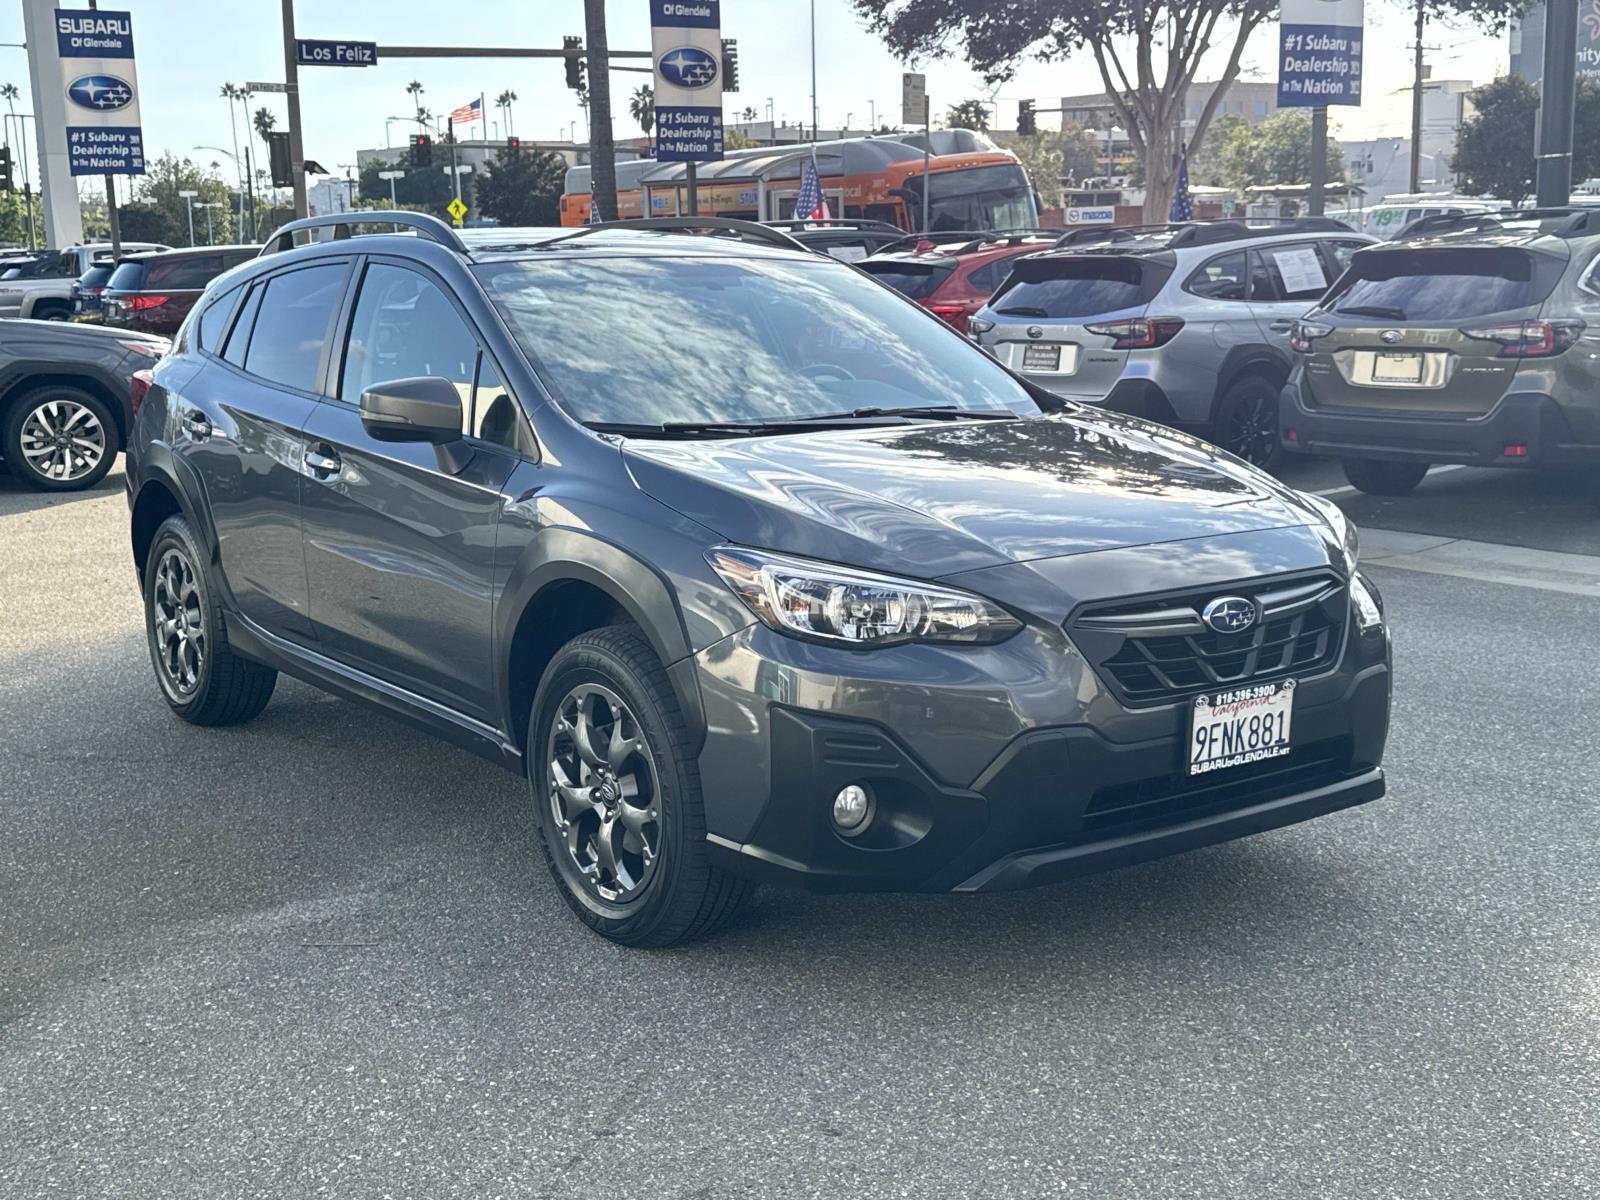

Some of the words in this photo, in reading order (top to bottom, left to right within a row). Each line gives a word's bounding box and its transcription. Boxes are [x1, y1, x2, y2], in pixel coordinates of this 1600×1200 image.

[663, 4, 674, 15] Of
[675, 4, 711, 17] Glendale
[58, 18, 130, 35] SUBARU
[71, 37, 82, 47] Of
[83, 37, 122, 48] Glendale
[1284, 34, 1303, 51] #1
[1305, 34, 1347, 51] Subaru
[302, 44, 331, 60] Los
[336, 45, 372, 62] Feliz
[1284, 56, 1349, 77] Dealership
[1303, 78, 1344, 94] Nation
[659, 112, 673, 124] #1
[675, 112, 709, 124] Subaru
[71, 132, 86, 143] #1
[87, 131, 126, 142] Subaru
[660, 127, 712, 141] Dealership
[72, 145, 129, 157] Dealership
[676, 142, 708, 152] Nation
[90, 157, 126, 167] Nation
[1081, 210, 1113, 220] mazda
[1216, 684, 1276, 705] 818-396-3900
[1211, 696, 1276, 717] California
[1193, 710, 1286, 762] 9FNK881
